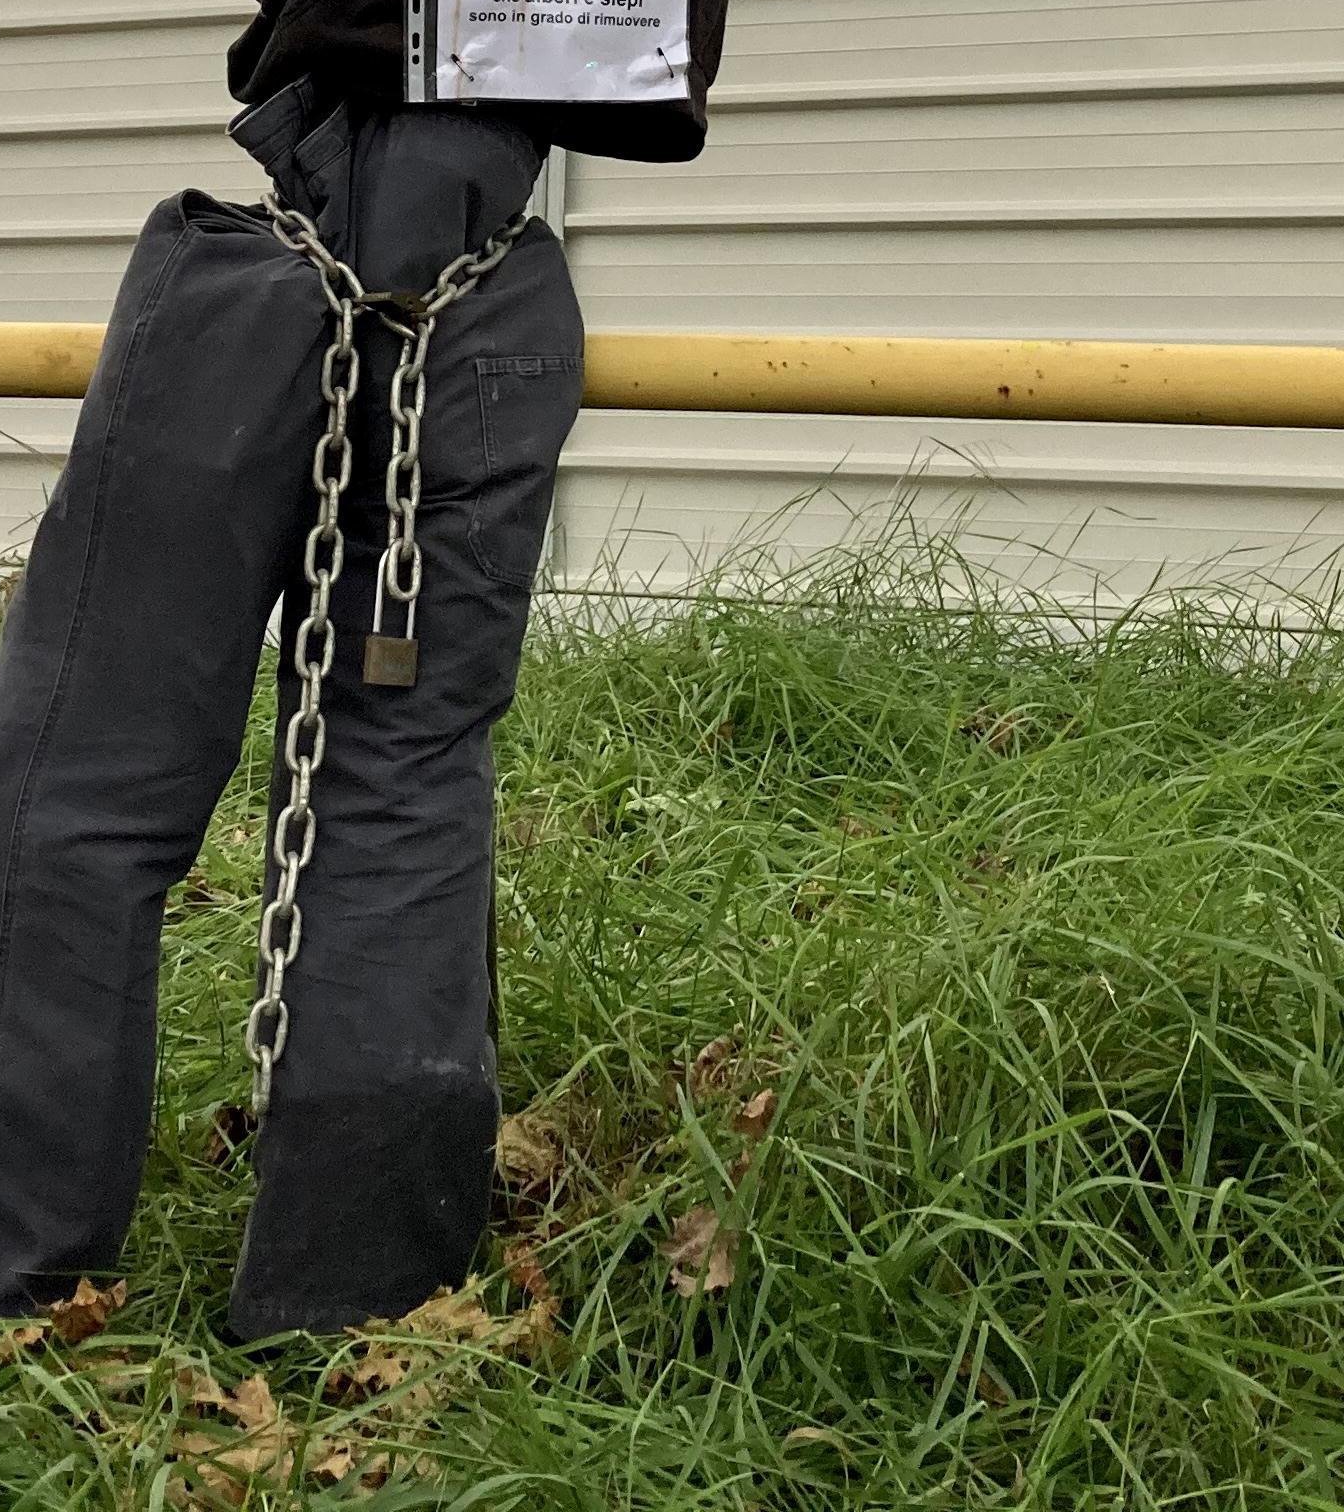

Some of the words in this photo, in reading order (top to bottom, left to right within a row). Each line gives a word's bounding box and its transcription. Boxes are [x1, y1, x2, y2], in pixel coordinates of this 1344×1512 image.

[468, 11, 507, 24] sono
[511, 8, 526, 23] in
[530, 9, 574, 27] grado
[577, 10, 591, 26] di
[594, 11, 661, 29] rimuovere
